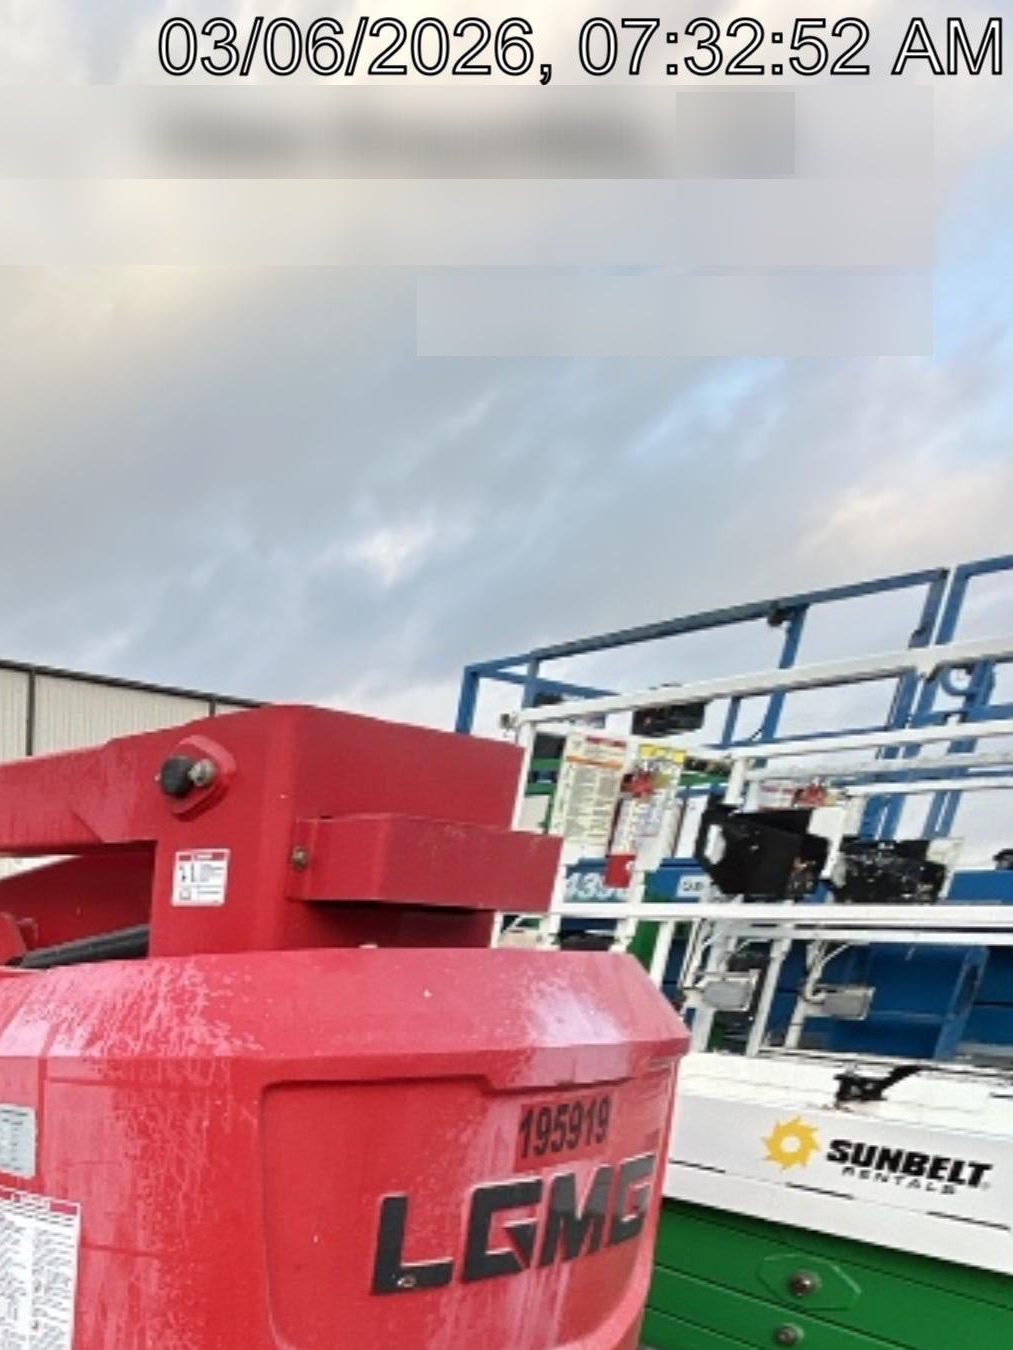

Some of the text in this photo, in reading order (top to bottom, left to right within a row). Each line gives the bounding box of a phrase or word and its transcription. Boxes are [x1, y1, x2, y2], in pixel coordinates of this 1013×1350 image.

[518, 1098, 611, 1159] 195919
[826, 1139, 992, 1188] SUNBELT
[841, 1166, 956, 1195] RENTALS
[372, 1152, 656, 1294] LGMG
